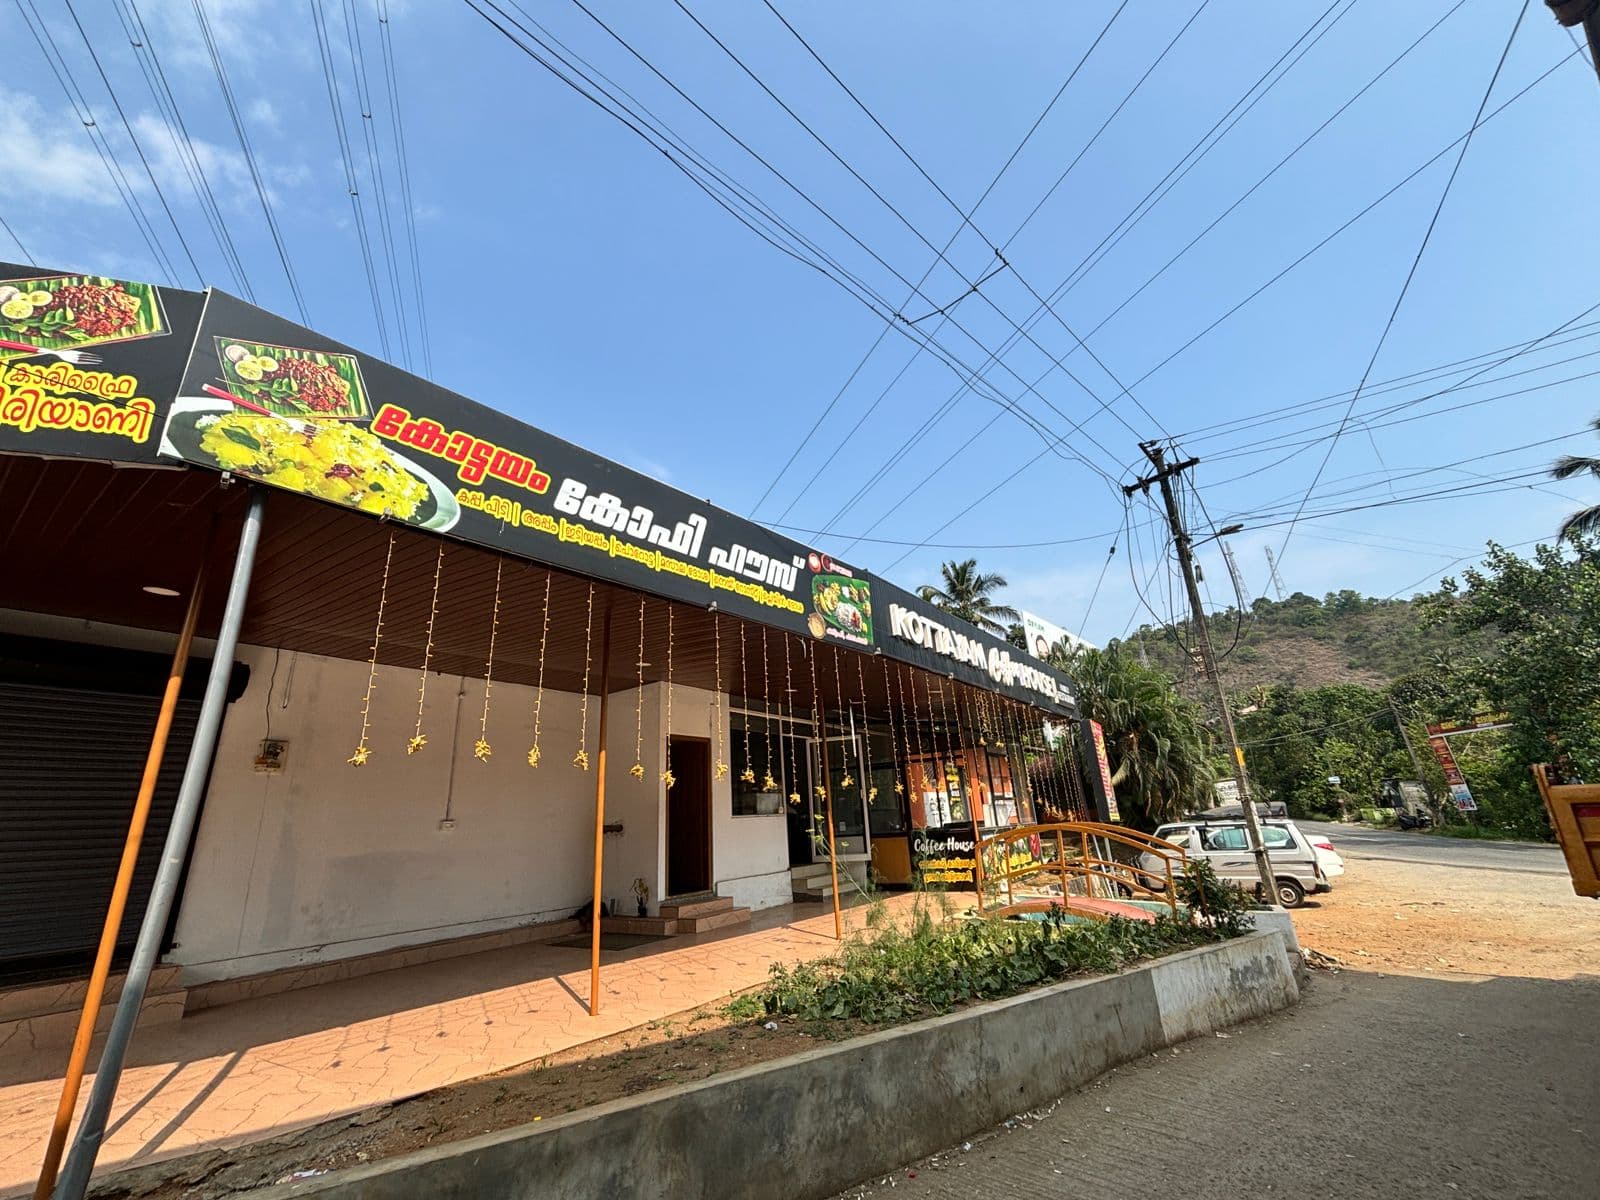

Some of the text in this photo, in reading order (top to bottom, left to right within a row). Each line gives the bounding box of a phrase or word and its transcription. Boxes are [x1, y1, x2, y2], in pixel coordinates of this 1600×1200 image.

[0, 385, 152, 441] രിയാണി
[372, 404, 806, 592] കോട്ടയം കോഫി ഹൗസ്
[889, 603, 988, 669] KOTTAYAM
[914, 836, 976, 855] Coffee House
